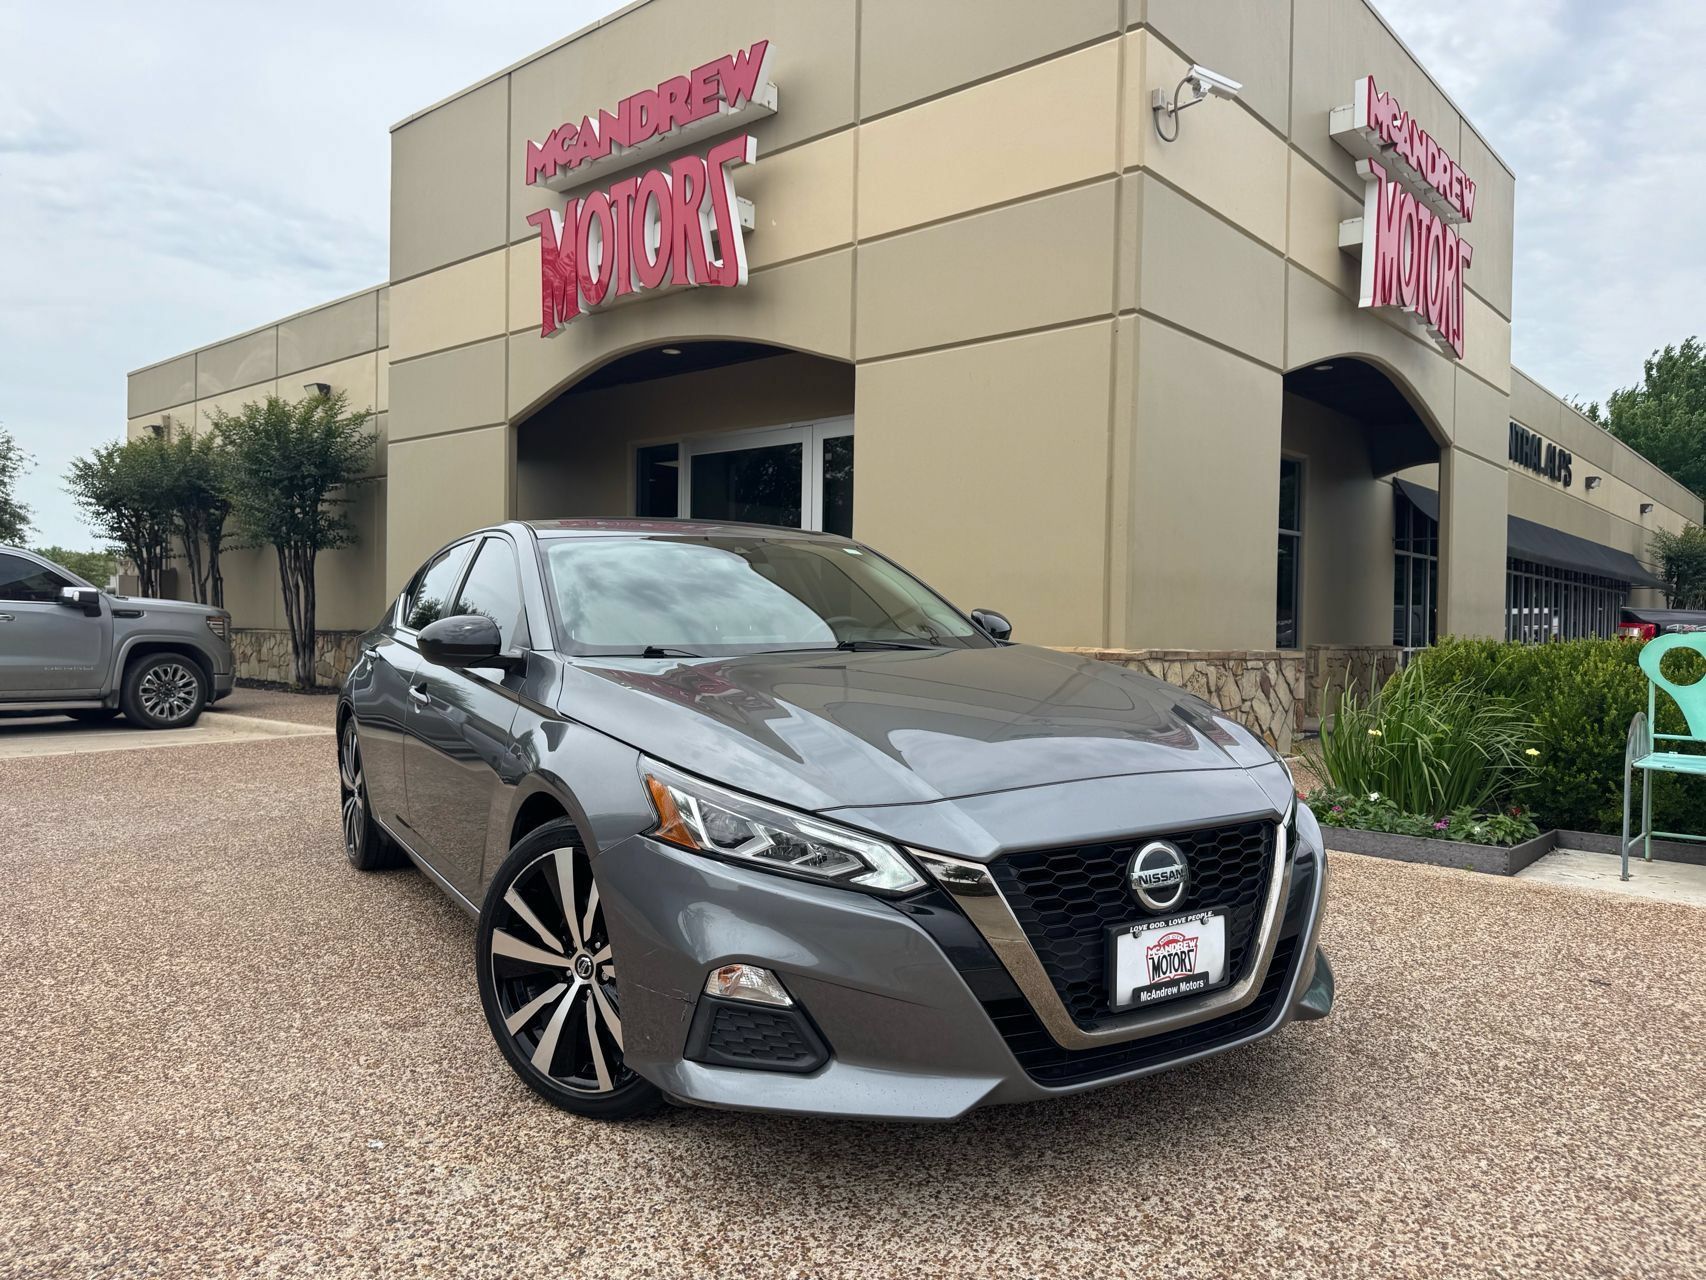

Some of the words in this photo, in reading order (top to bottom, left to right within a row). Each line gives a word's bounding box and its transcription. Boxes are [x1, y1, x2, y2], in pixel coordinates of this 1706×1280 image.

[526, 134, 752, 338] MOTORS
[1366, 157, 1473, 360] MOTORS
[1138, 868, 1184, 885] NISSAN
[1129, 924, 1148, 933] LOVE
[1168, 917, 1187, 926] LOVE
[1149, 949, 1194, 981] MOTORS
[1141, 985, 1178, 1002] McAndrew
[1180, 979, 1204, 993] Motors
